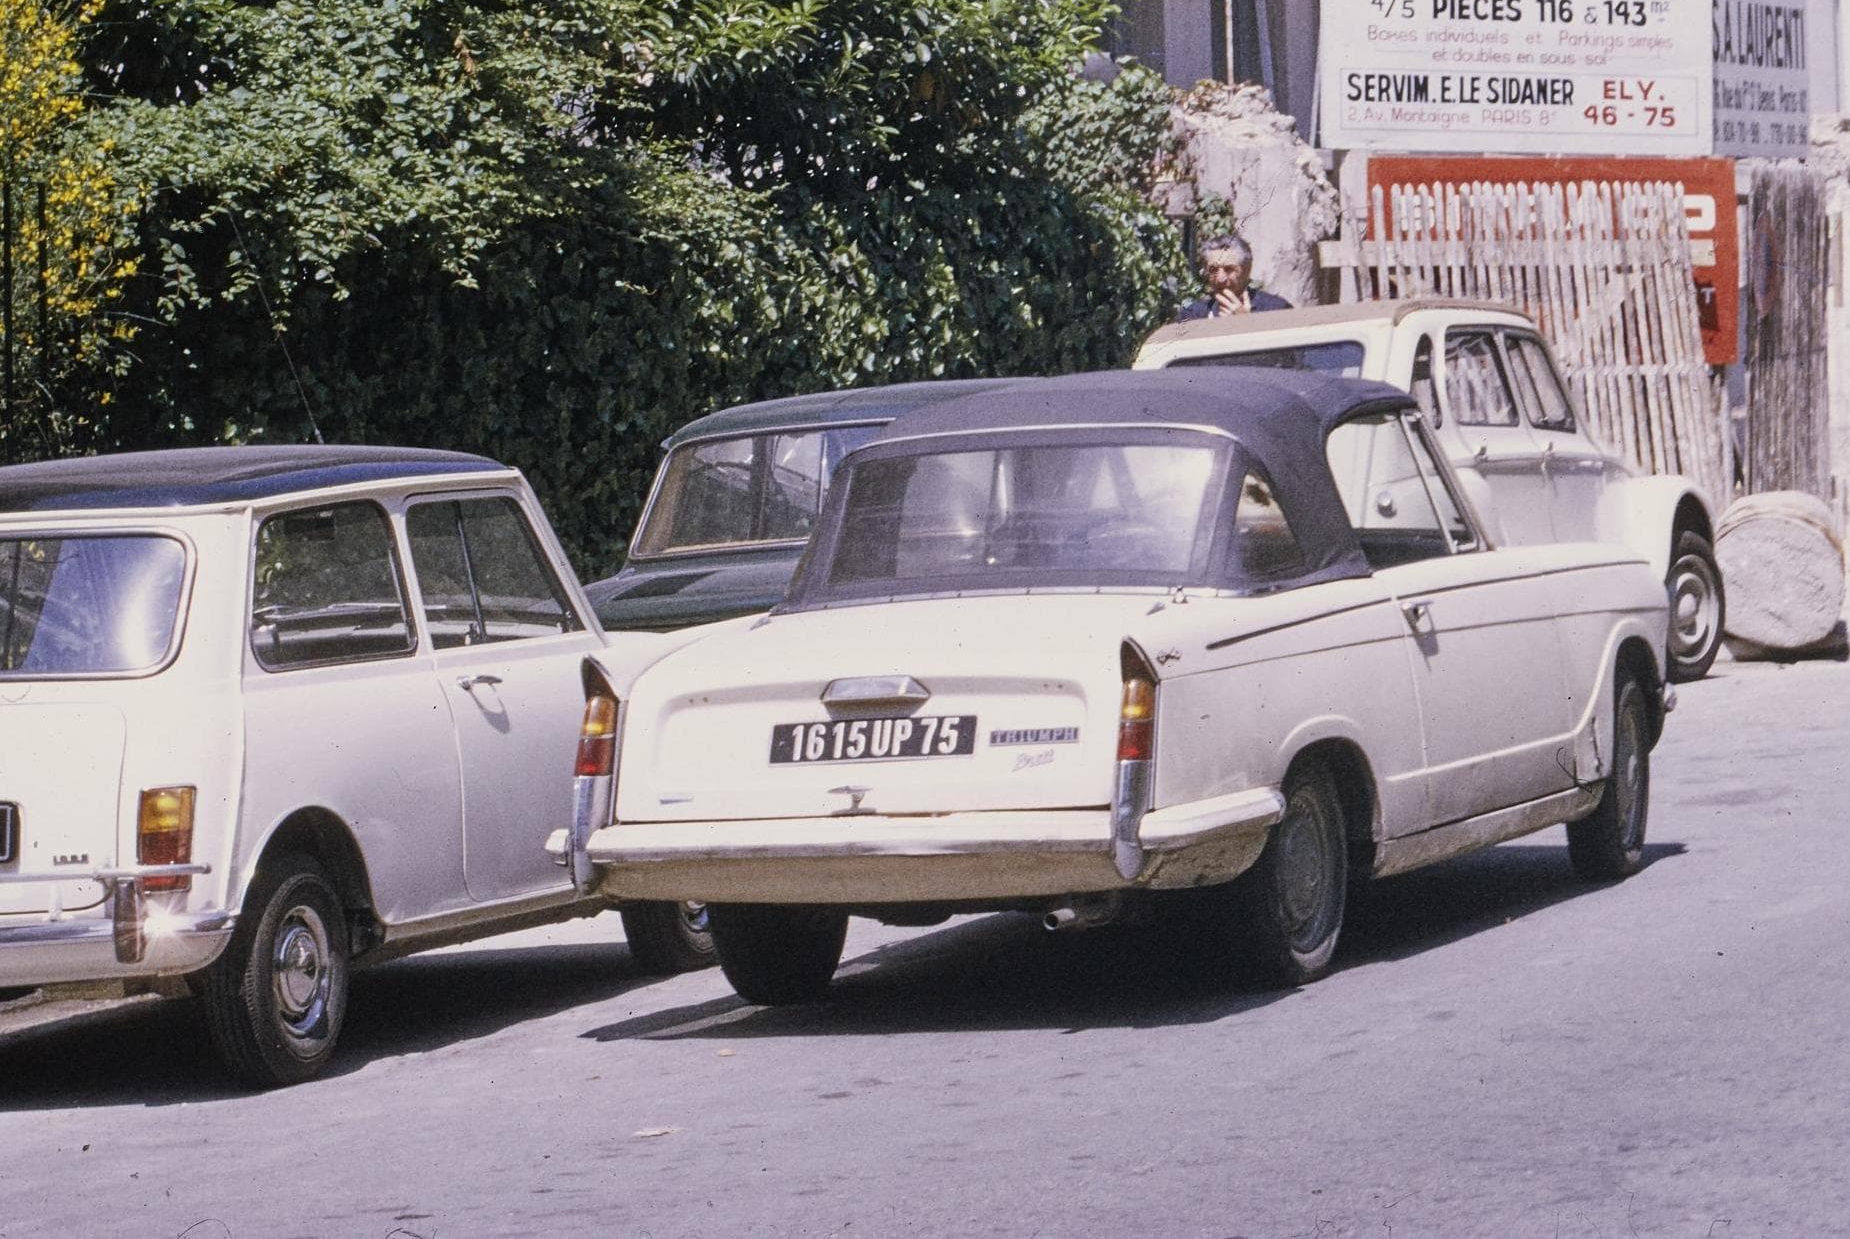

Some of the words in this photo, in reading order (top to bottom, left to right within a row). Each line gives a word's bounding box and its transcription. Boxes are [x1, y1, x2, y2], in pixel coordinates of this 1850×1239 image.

[1425, 26, 1510, 46] individuels
[1525, 32, 1542, 45] et
[1558, 29, 1625, 53] Parkings
[1431, 48, 1448, 62] et
[1451, 47, 1511, 63] doubles
[1516, 51, 1536, 64] en
[1539, 51, 1577, 66] sous
[1486, 77, 1575, 106] SIDANER
[1603, 80, 1665, 101] ELY.
[1390, 108, 1471, 129] Montaigne
[1481, 110, 1533, 125] PARIS
[991, 727, 1079, 745] TRIUMPH
